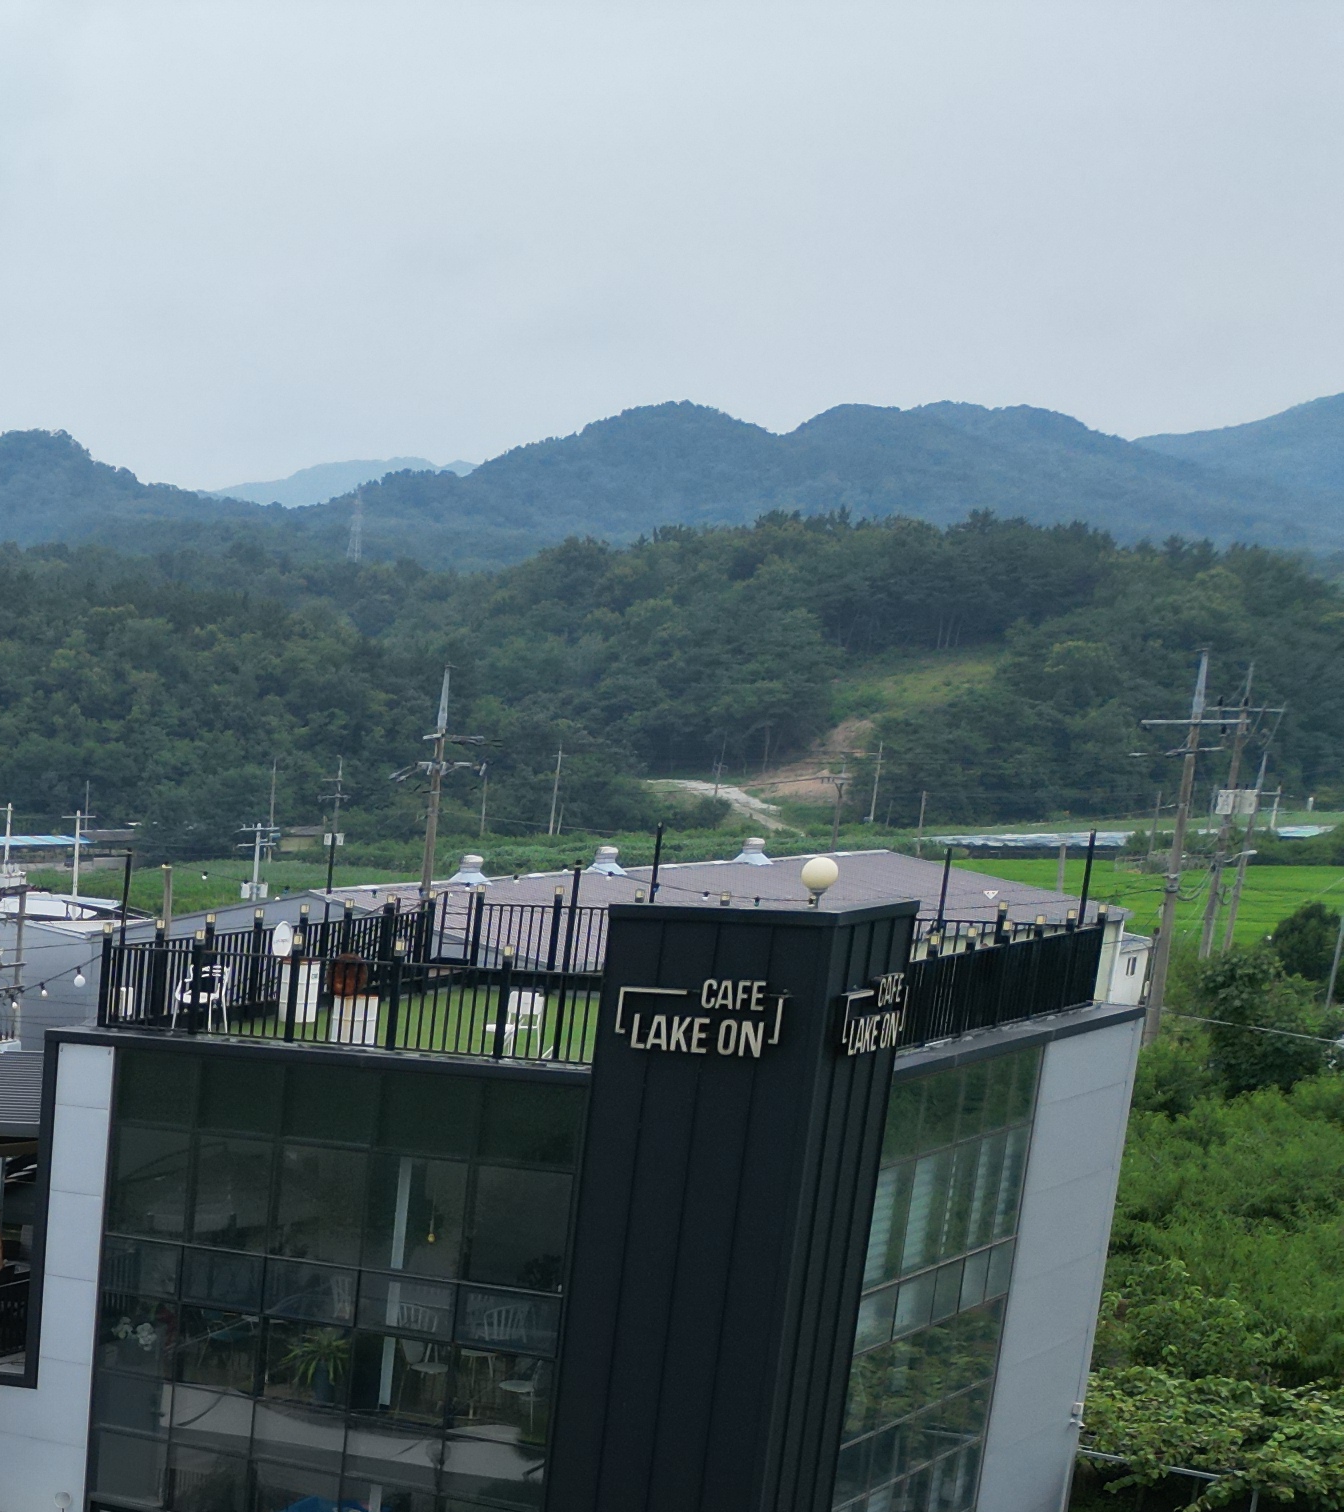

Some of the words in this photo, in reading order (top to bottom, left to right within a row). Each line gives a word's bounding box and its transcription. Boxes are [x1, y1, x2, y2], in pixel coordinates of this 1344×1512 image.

[701, 979, 766, 1011] CAFE
[877, 973, 905, 1008] CAFE
[630, 1013, 710, 1054] LAKE
[717, 1019, 764, 1058] ON
[848, 1015, 881, 1056] LAKE
[879, 1011, 900, 1049] ON
